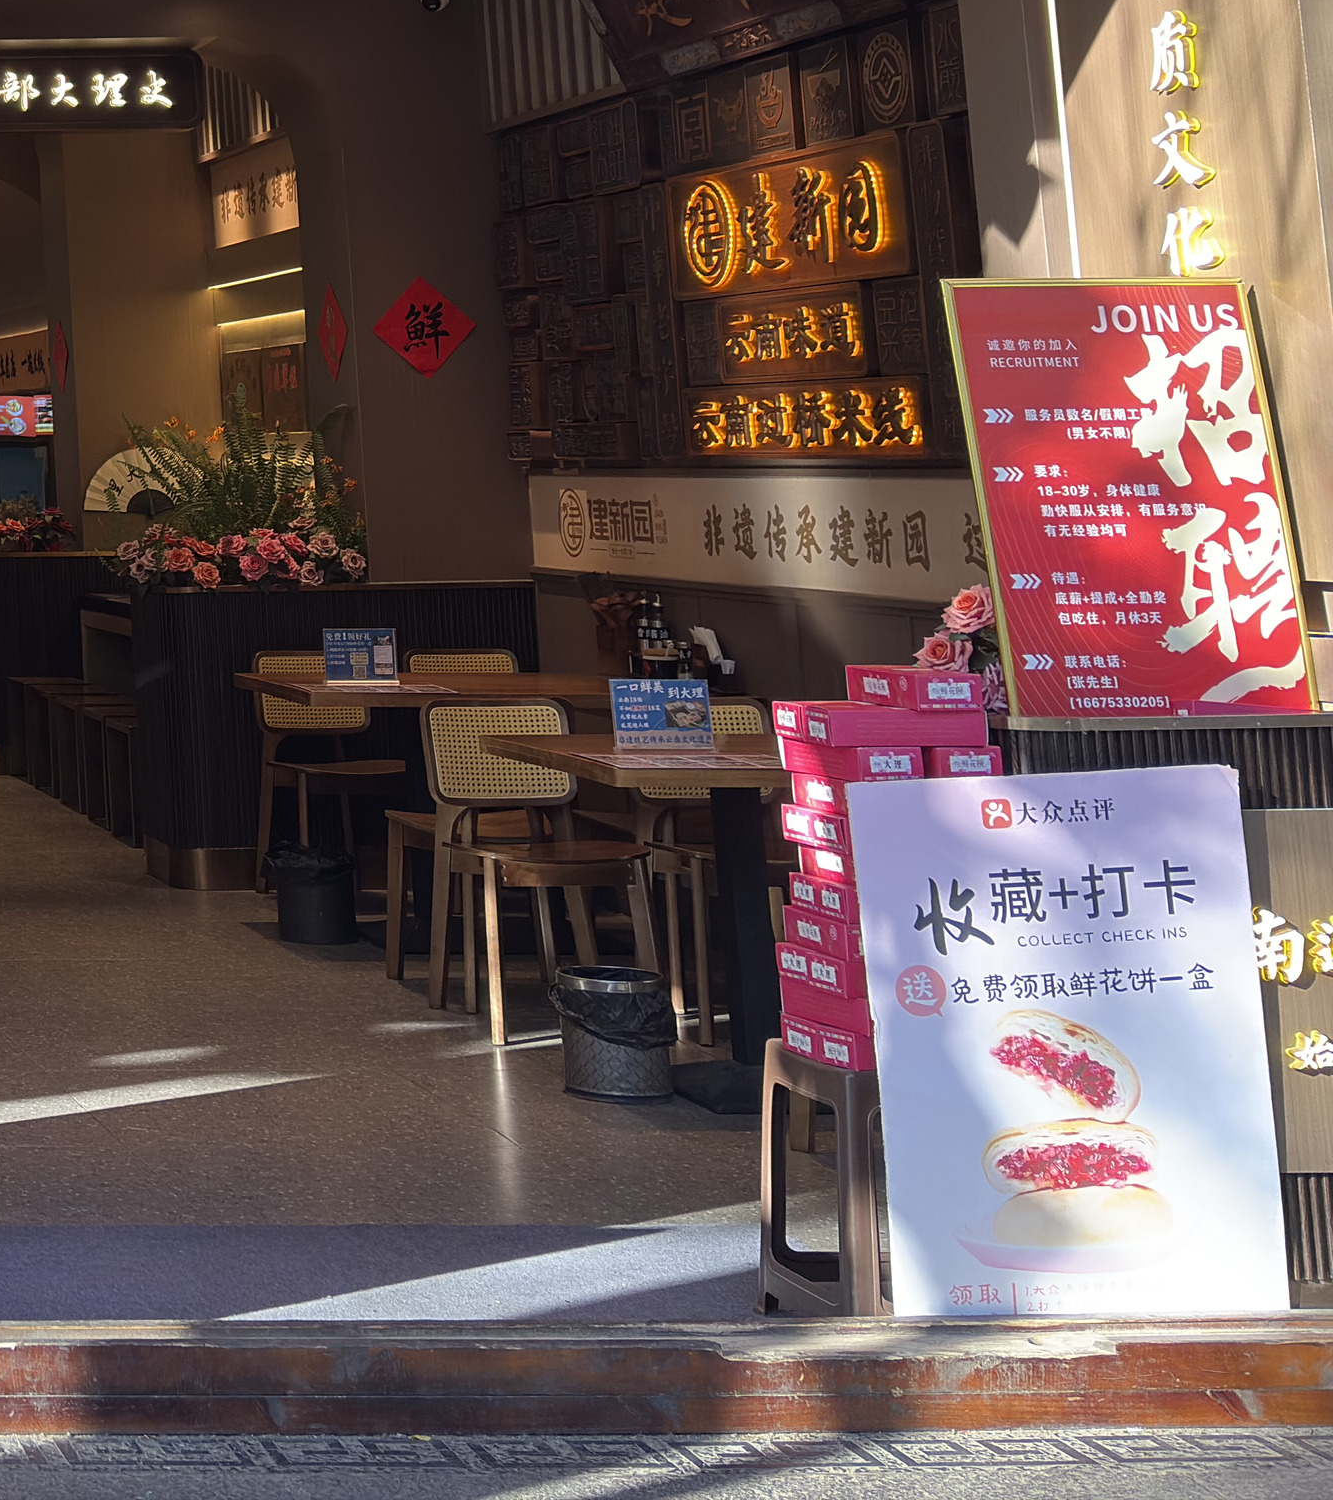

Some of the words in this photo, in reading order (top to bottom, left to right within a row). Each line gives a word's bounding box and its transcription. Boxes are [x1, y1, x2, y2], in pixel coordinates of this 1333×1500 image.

[725, 302, 863, 363] 云南味道
[1091, 305, 1180, 334] JOIN
[1188, 303, 1238, 332] US
[986, 337, 1079, 353] 诚邀你的加入
[989, 356, 1080, 369] RECRUITMENT
[692, 386, 923, 449] 云南过桥米线
[587, 498, 654, 544] 建新园
[1123, 327, 1306, 703] 招聘
[703, 503, 931, 572] 非遗传承建新园
[1043, 523, 1128, 538] 有无经验均可
[1055, 590, 1167, 606] 底薪+提成+全勤奖
[616, 680, 665, 694] 一口鲜美
[668, 686, 705, 699] 到大理
[1067, 675, 1119, 690] [张先生]
[1070, 695, 1171, 710] [16675330205]
[1016, 797, 1116, 825] 大众点评
[914, 860, 1197, 956] 收藏+打卡
[1017, 932, 1094, 947] COLLECT
[1102, 929, 1157, 943] CHECK
[1162, 927, 1188, 940] INS
[1252, 906, 1333, 984] 南
[902, 972, 934, 1006] 送
[950, 962, 1215, 1004] 免费领取鲜花饼一盒
[949, 1284, 1002, 1306] 领取
